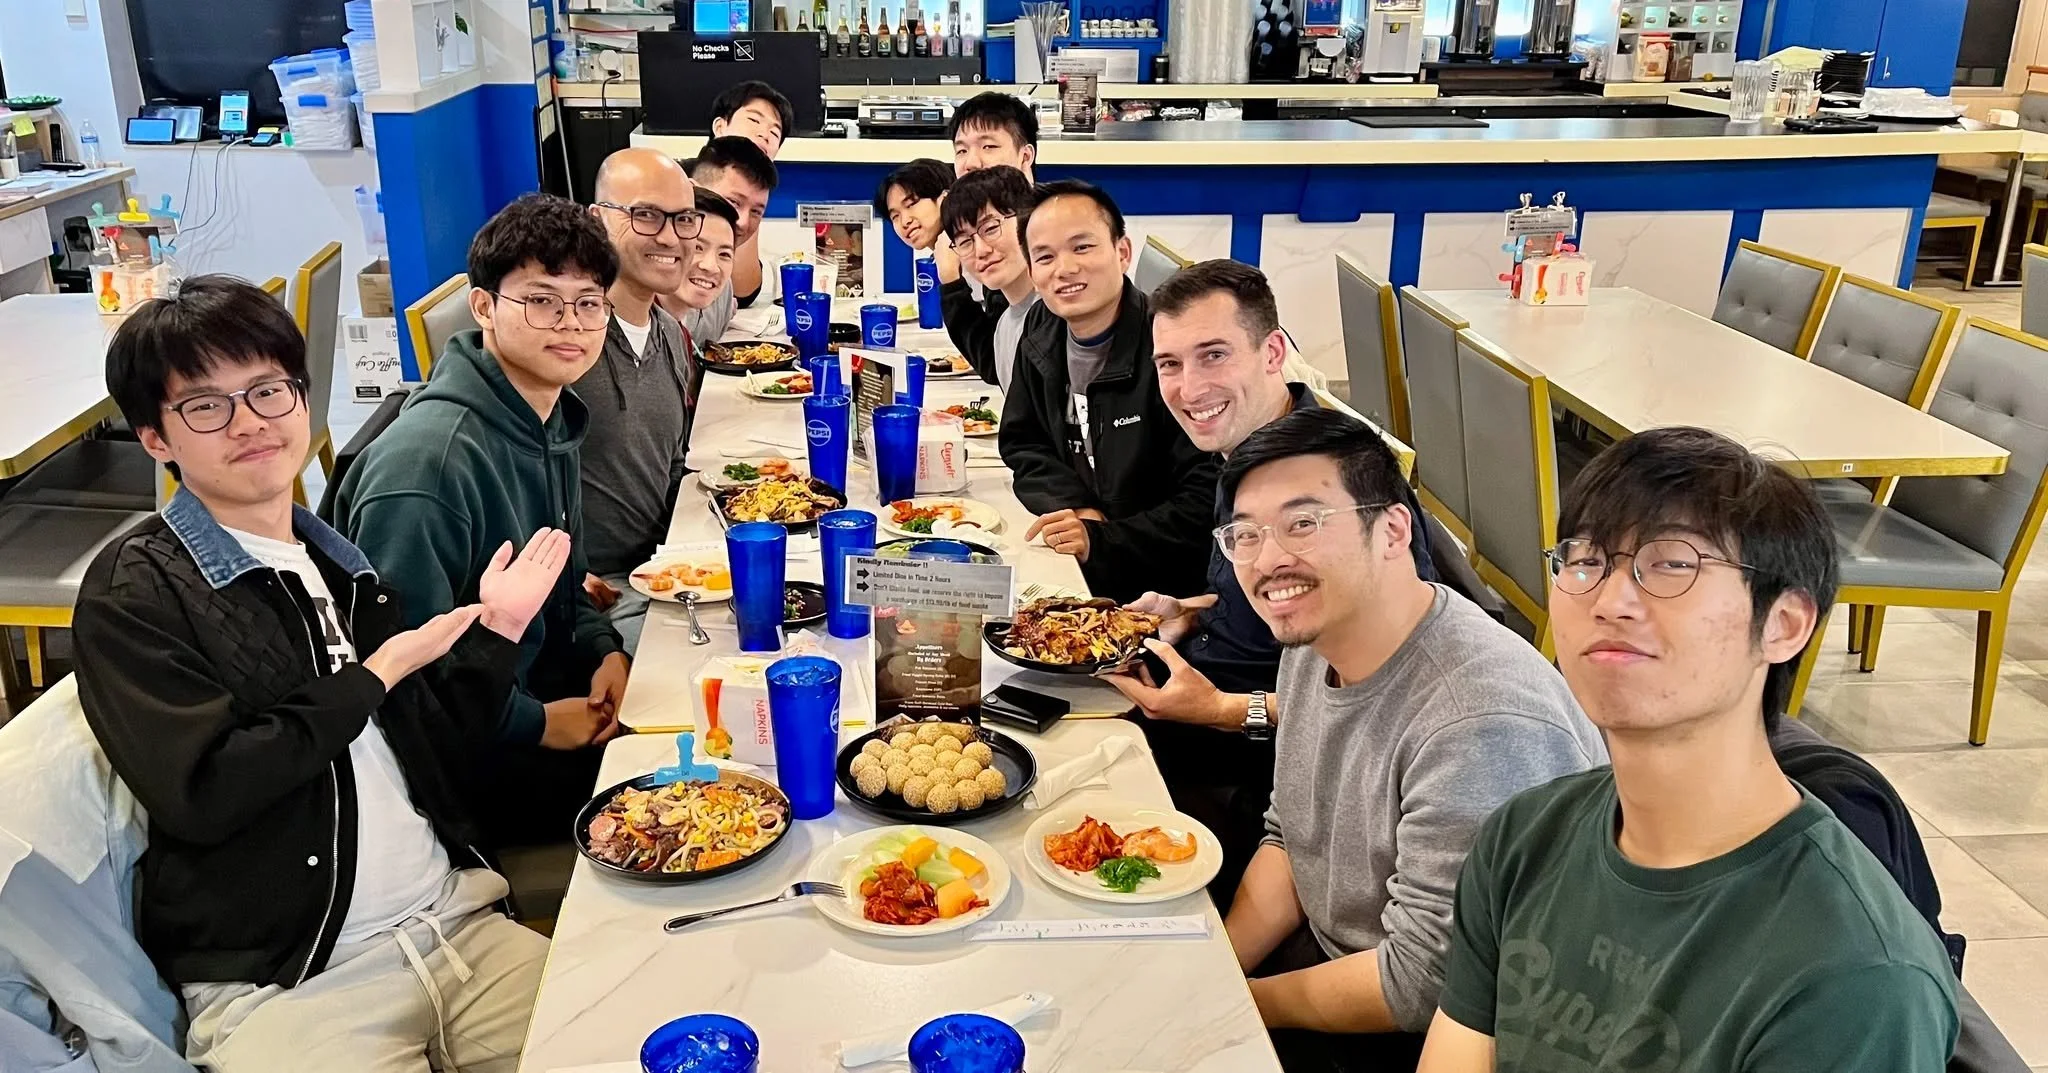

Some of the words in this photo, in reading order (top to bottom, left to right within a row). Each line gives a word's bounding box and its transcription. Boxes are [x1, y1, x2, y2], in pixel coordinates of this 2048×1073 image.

[703, 44, 730, 52] Checks
[692, 52, 716, 60] Please
[873, 330, 893, 338] PEPSI
[808, 428, 830, 438] PEPSI
[883, 558, 922, 569] Reminder
[873, 571, 894, 580] Limited
[755, 699, 768, 745] NAPKINS
